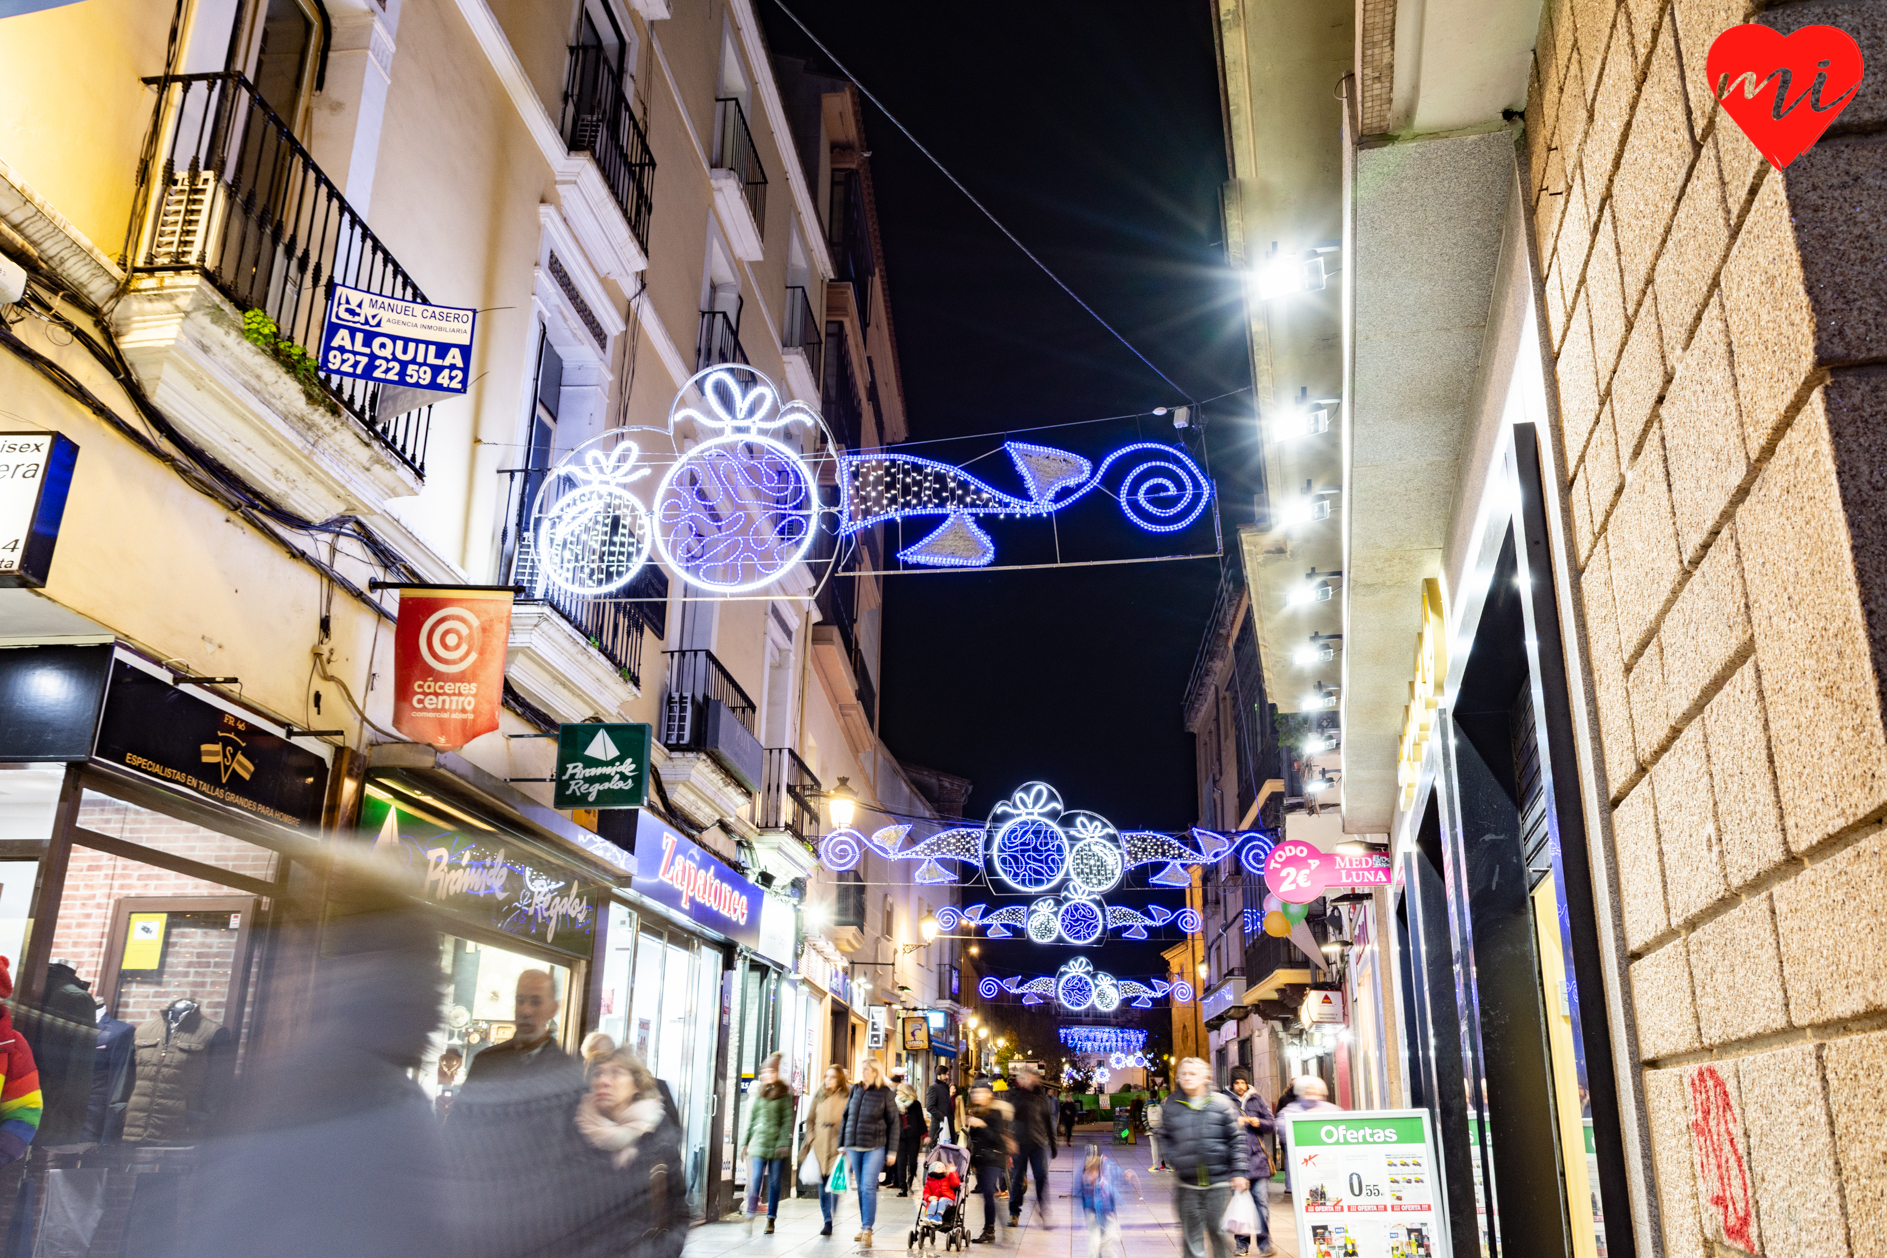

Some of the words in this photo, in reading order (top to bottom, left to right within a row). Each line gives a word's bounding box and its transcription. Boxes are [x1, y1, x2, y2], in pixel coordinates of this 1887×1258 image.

[369, 298, 417, 318] MANUEL
[421, 308, 470, 324] CASERO
[386, 317, 418, 329] AGENCIA
[420, 324, 468, 335] INMOBILIARIA
[330, 328, 464, 368] ALQUILA
[327, 350, 369, 375] 927
[372, 359, 400, 381] 22
[405, 364, 432, 386] 59
[436, 368, 463, 389] 42
[413, 677, 477, 694] cáceres
[411, 711, 449, 719] comercial
[451, 712, 474, 720] abierto
[412, 694, 475, 711] centro
[125, 752, 187, 784] ESPECIALISTAS
[186, 775, 198, 788] EN
[198, 780, 225, 799] TALLAS
[224, 791, 257, 811] GRANDES
[257, 803, 274, 818] PARA
[274, 810, 301, 828] HOMBRE
[565, 774, 634, 802] Regalos
[1269, 845, 1308, 871] TODO
[1307, 859, 1320, 871] A
[1334, 856, 1379, 869] MED
[1278, 866, 1311, 893] 2€
[1340, 870, 1387, 883] LUNA
[528, 879, 588, 944] Regalos
[1320, 1125, 1398, 1144] Ofertas
